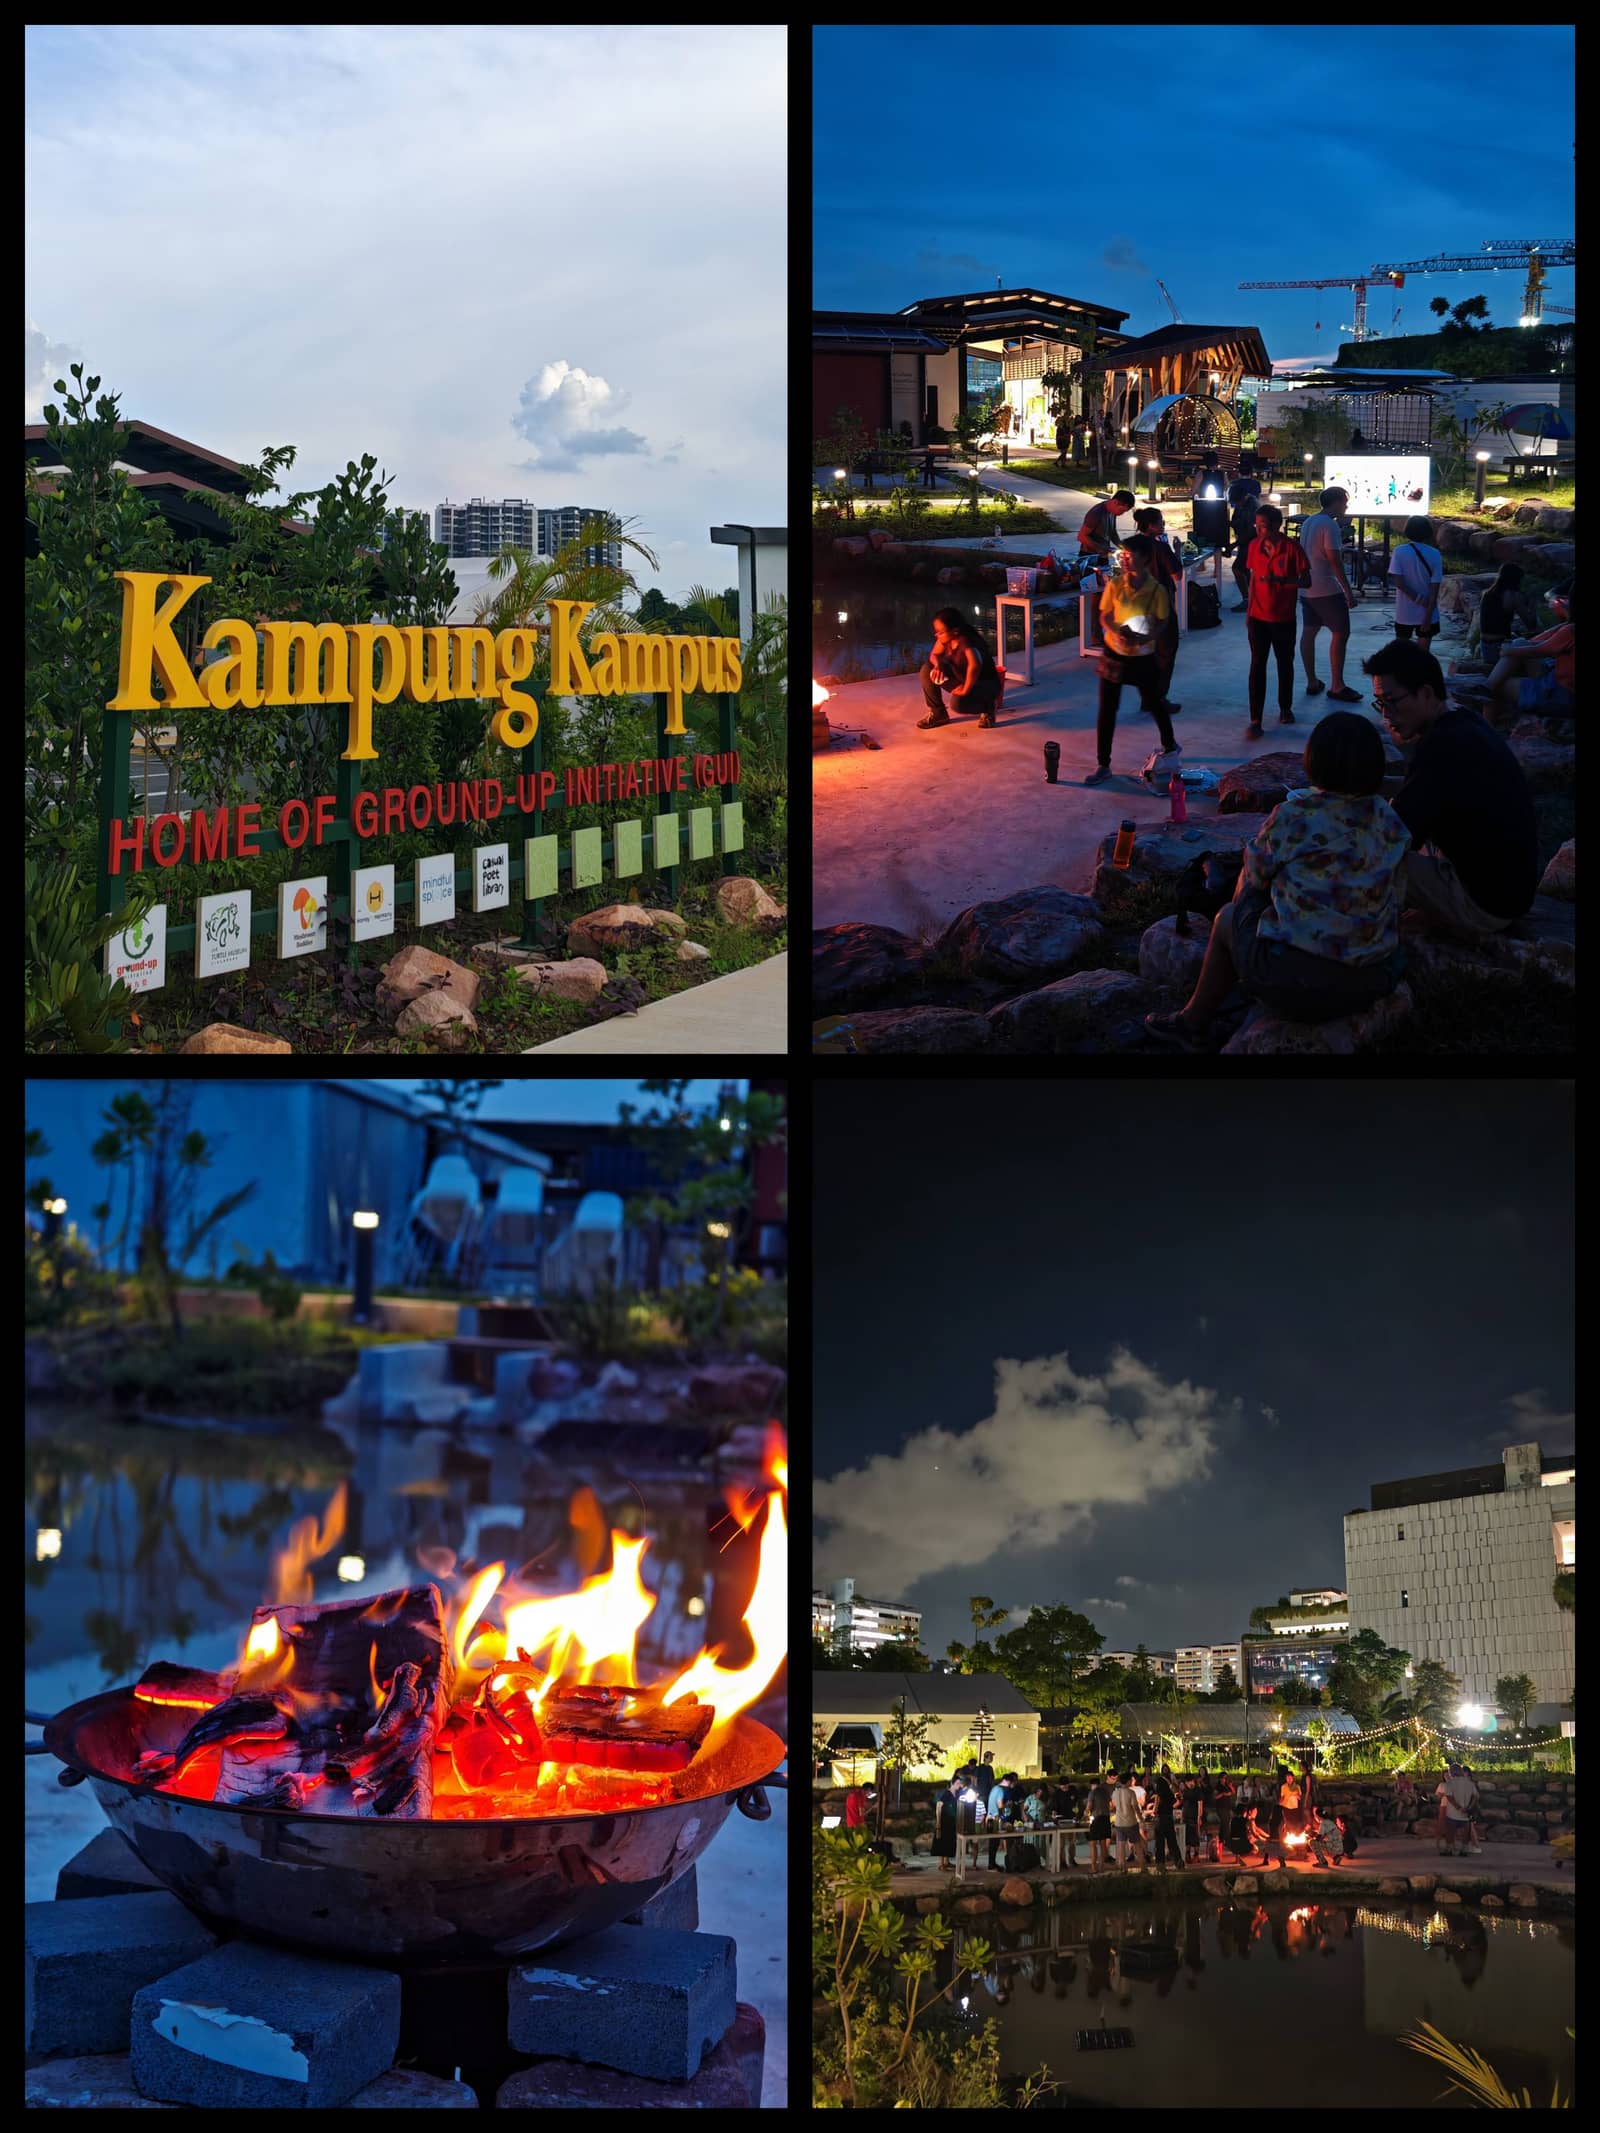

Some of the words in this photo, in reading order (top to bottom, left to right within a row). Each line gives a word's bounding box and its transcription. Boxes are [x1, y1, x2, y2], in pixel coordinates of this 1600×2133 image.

[107, 570, 538, 759] Kampung
[547, 599, 743, 735] Kampus
[108, 803, 261, 875] HOME
[279, 795, 336, 849] OF
[353, 771, 556, 838] GROUND-UP
[565, 756, 688, 807] INITIATIVE
[694, 751, 740, 788] (GUI)
[423, 872, 453, 889] mindful
